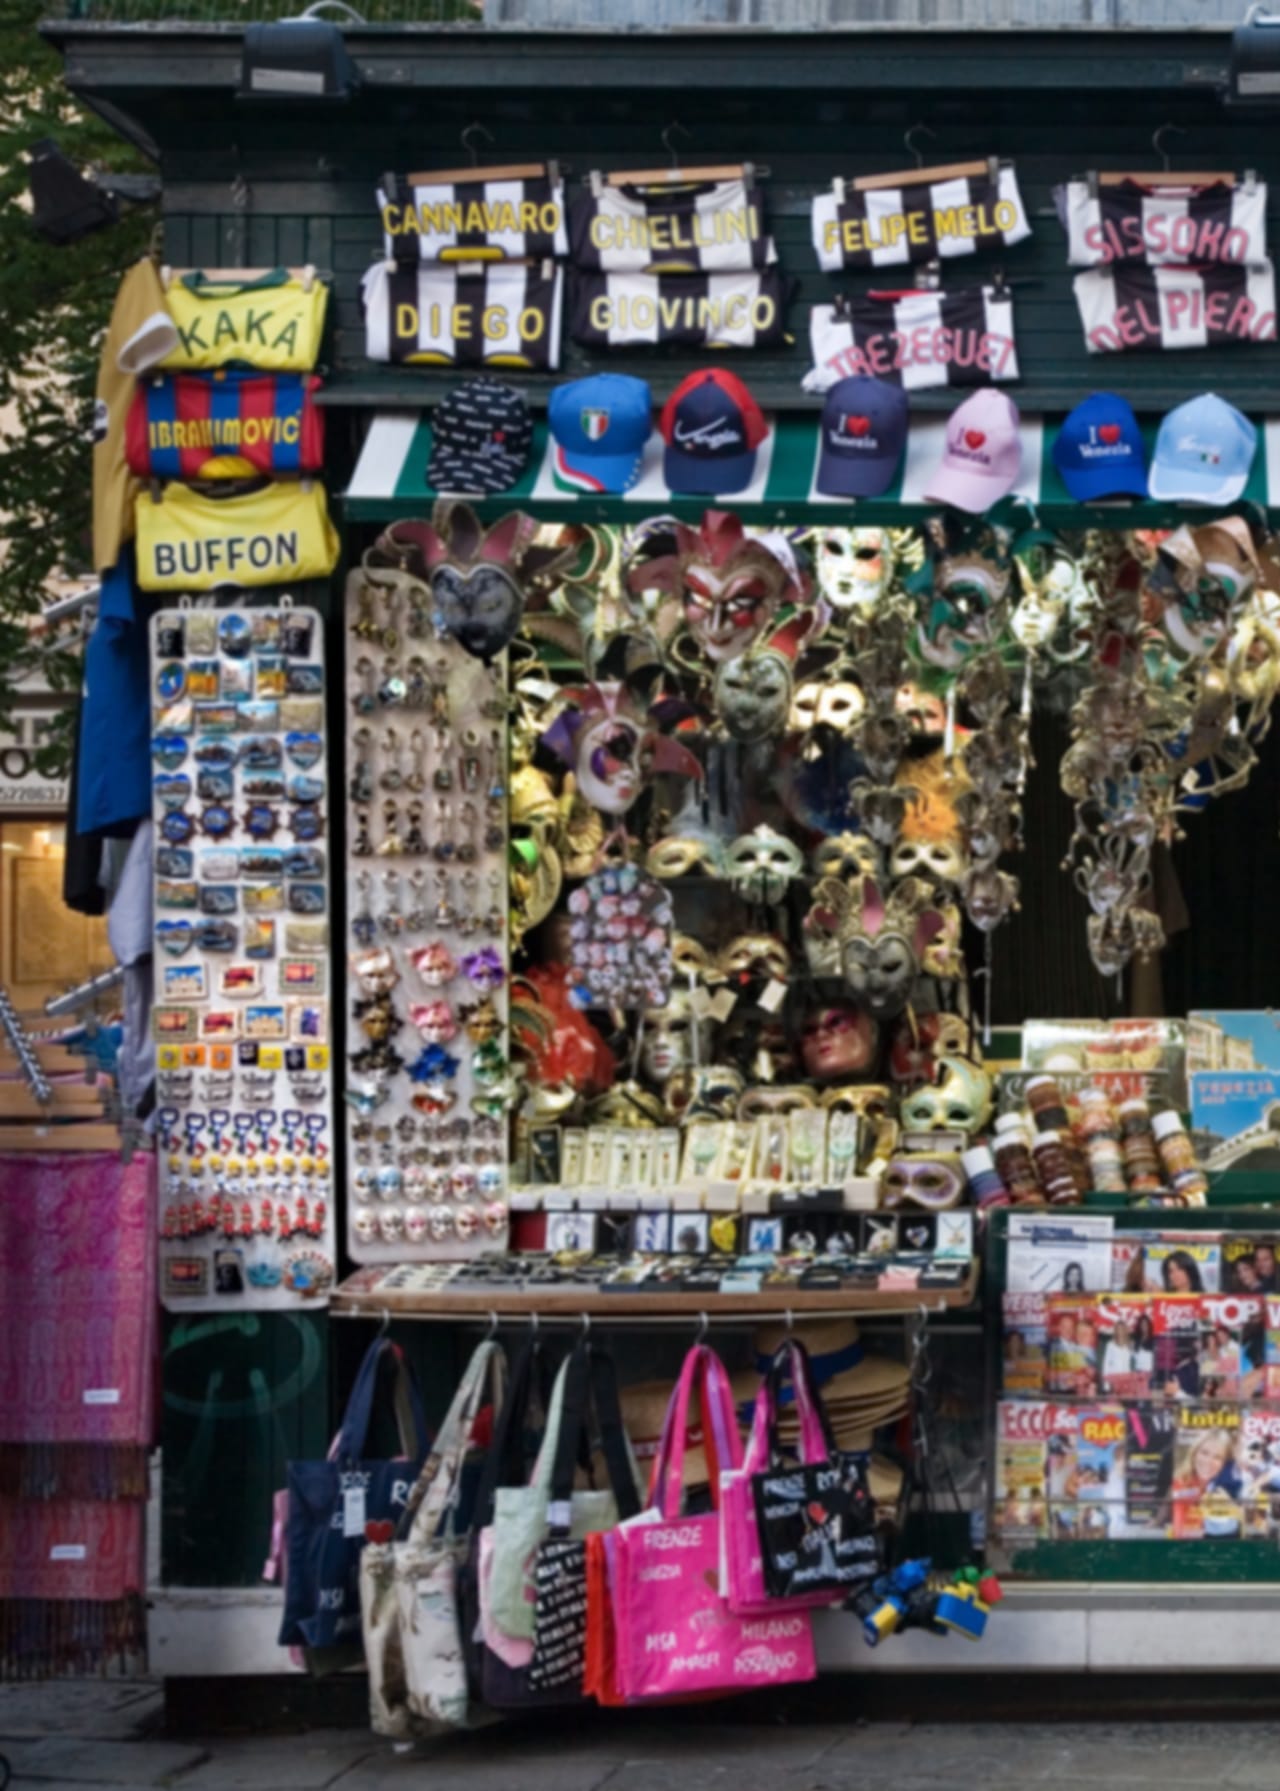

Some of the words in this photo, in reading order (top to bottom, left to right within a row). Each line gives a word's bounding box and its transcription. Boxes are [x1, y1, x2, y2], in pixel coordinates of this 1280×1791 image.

[383, 201, 560, 236] CANNAVARO
[590, 207, 759, 250] CHIELLINI
[823, 209, 928, 253] FELIPE
[933, 200, 1017, 238] MELO
[396, 304, 544, 340] DIEGO
[589, 294, 775, 330] GIOVINCO
[1078, 444, 1132, 458] Venezia
[1089, 425, 1097, 444] I
[153, 530, 298, 577] BUFFON
[1198, 1080, 1275, 1096] VENEZIA
[643, 1525, 704, 1550] FIRENZE
[741, 1618, 804, 1641] MILANO
